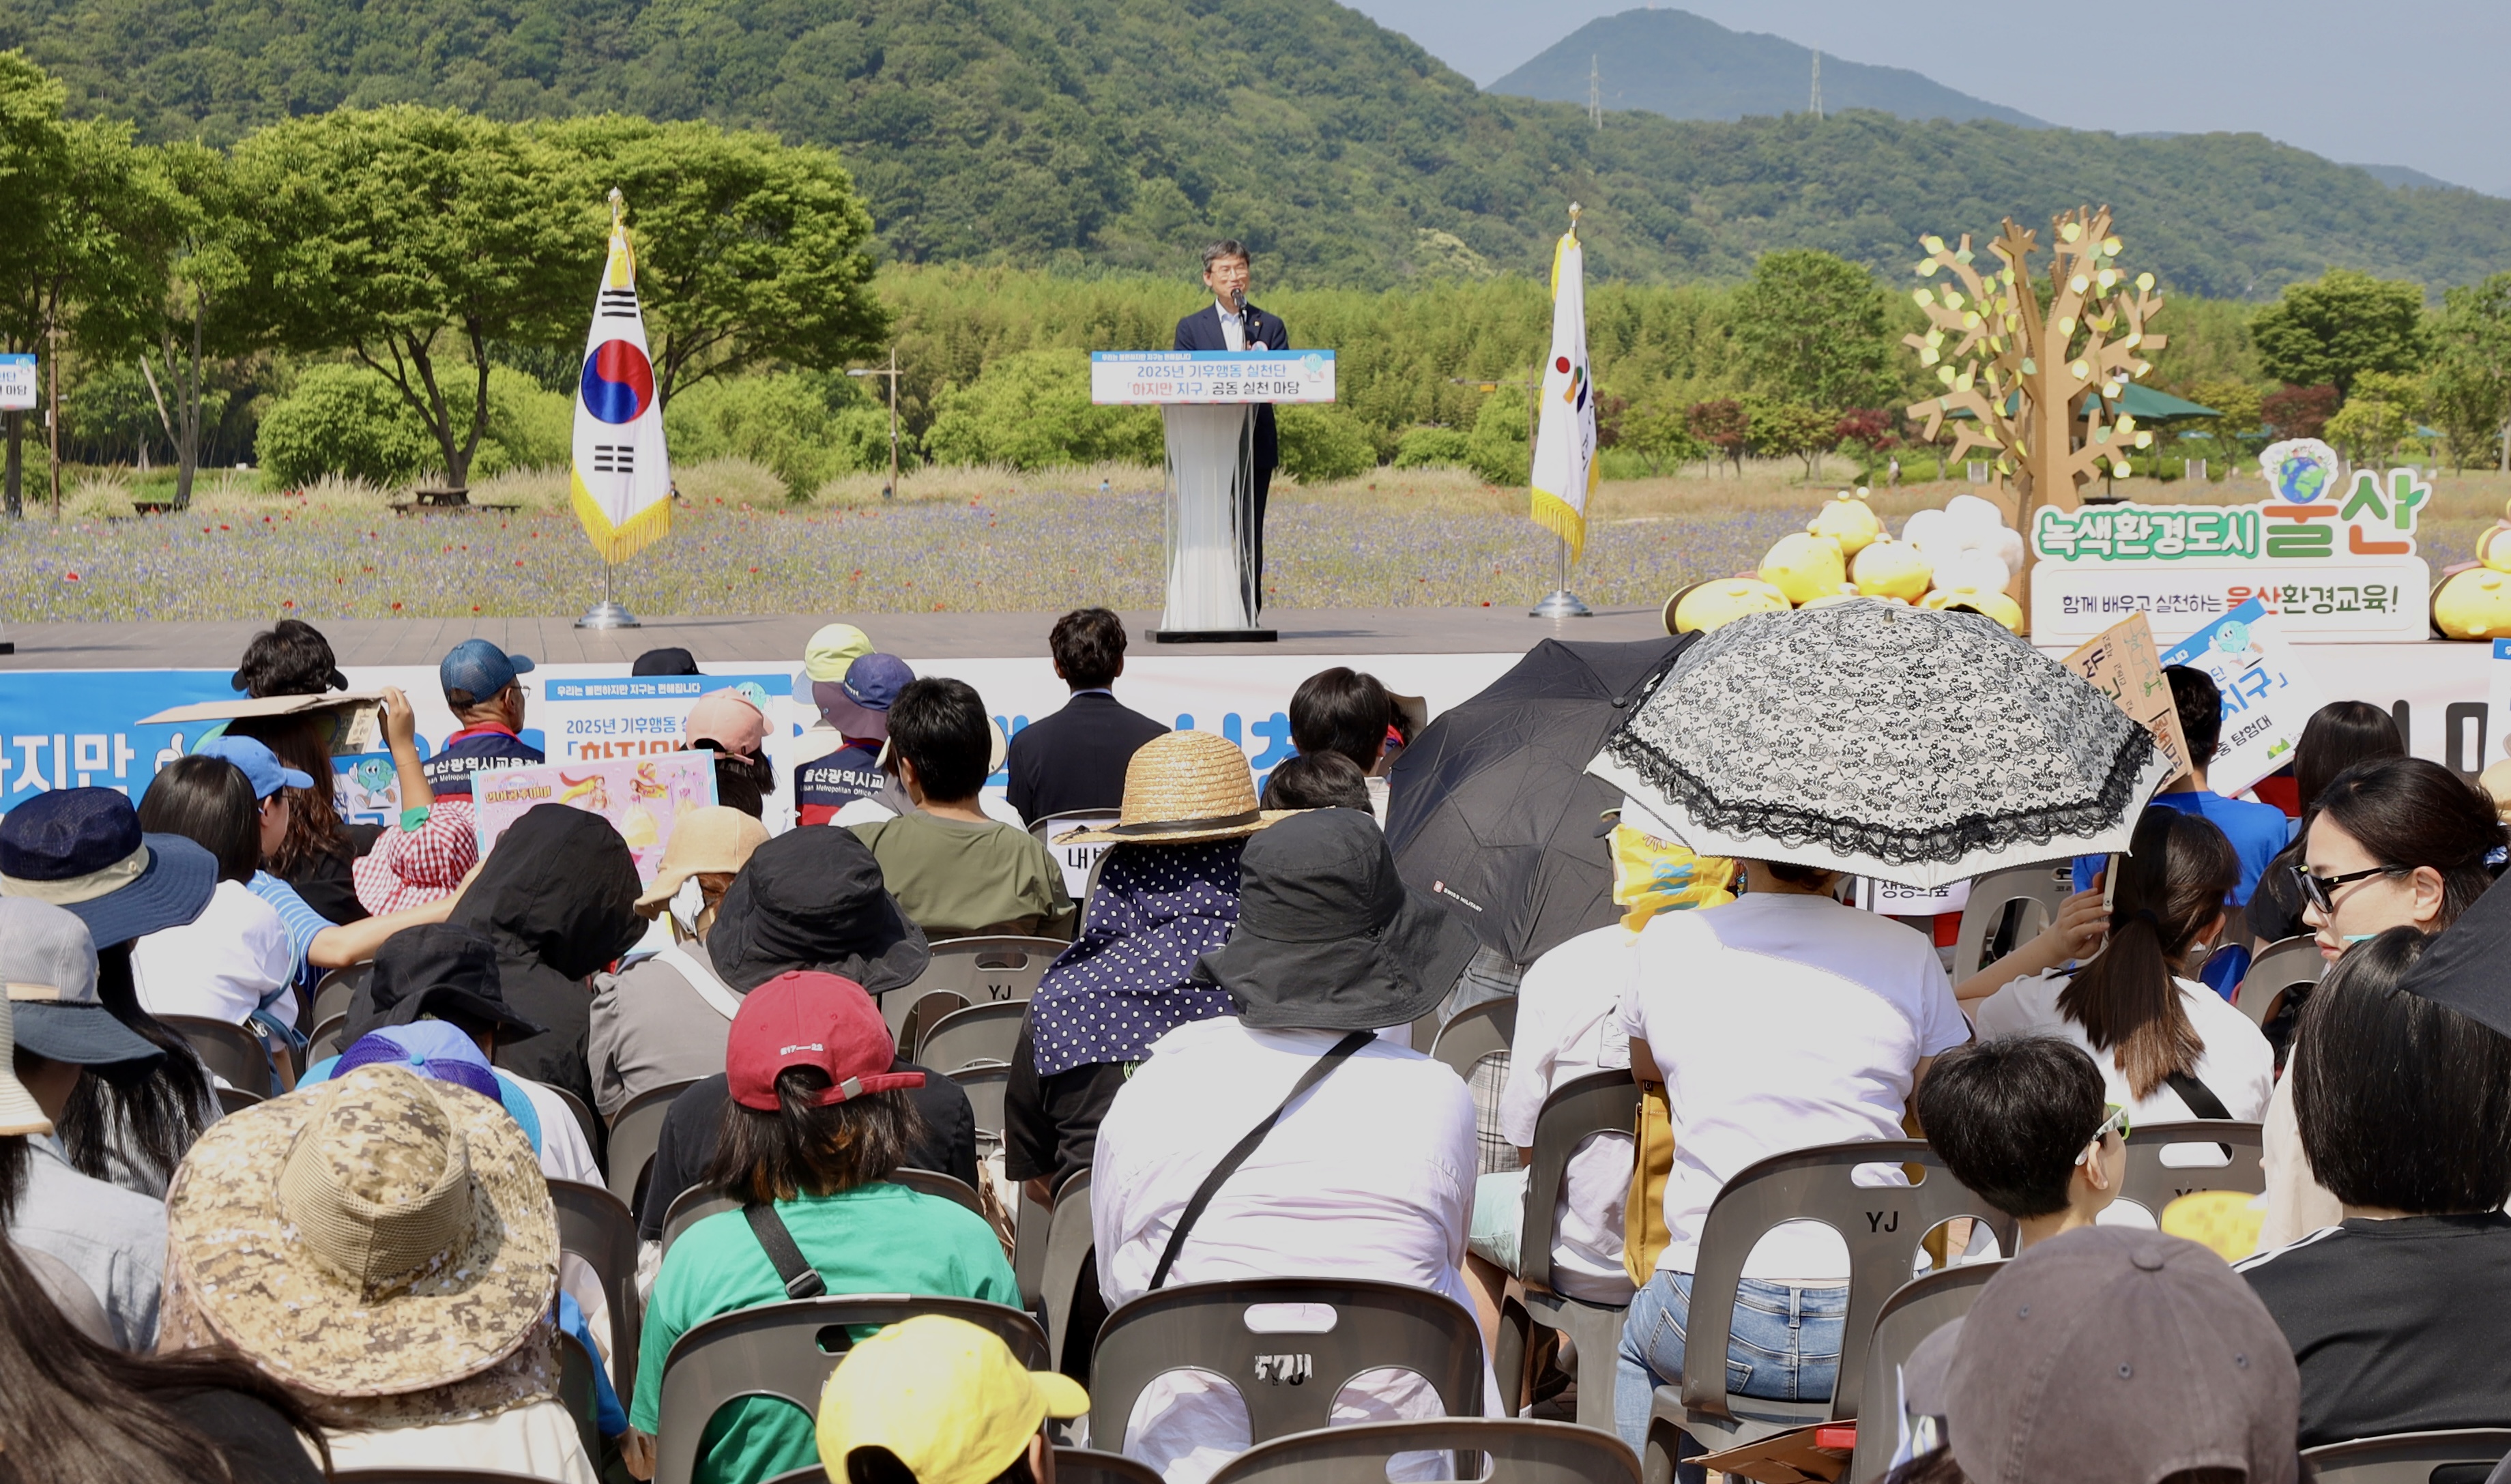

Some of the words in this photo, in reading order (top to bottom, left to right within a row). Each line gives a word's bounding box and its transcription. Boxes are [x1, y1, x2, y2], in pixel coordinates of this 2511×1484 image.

[1137, 364, 1185, 379] 2025년
[1189, 364, 1242, 378] 기후행동
[1247, 364, 1286, 378] 실천단
[1212, 381, 1238, 396] 공동
[1243, 381, 1269, 395] 실천
[1273, 381, 1300, 395] 마당
[2041, 511, 2256, 557] 녹색환경도시
[2263, 456, 2419, 558] 울산
[2062, 595, 2097, 614] 함께
[2102, 595, 2151, 613] 배우고
[2156, 594, 2222, 613] 실천하는
[557, 684, 583, 697] 우리는
[585, 684, 628, 697] 불편하지만
[630, 683, 656, 695] 지구는
[658, 682, 701, 695] 편해집니다
[566, 718, 616, 735] 2025년
[621, 716, 676, 733] 기후행동
[2231, 714, 2273, 747] 탐험대
[815, 783, 852, 795] Metropolitan
[853, 788, 872, 797] Office
[987, 984, 1012, 1001] YJ
[1865, 1210, 1899, 1234] YJ
